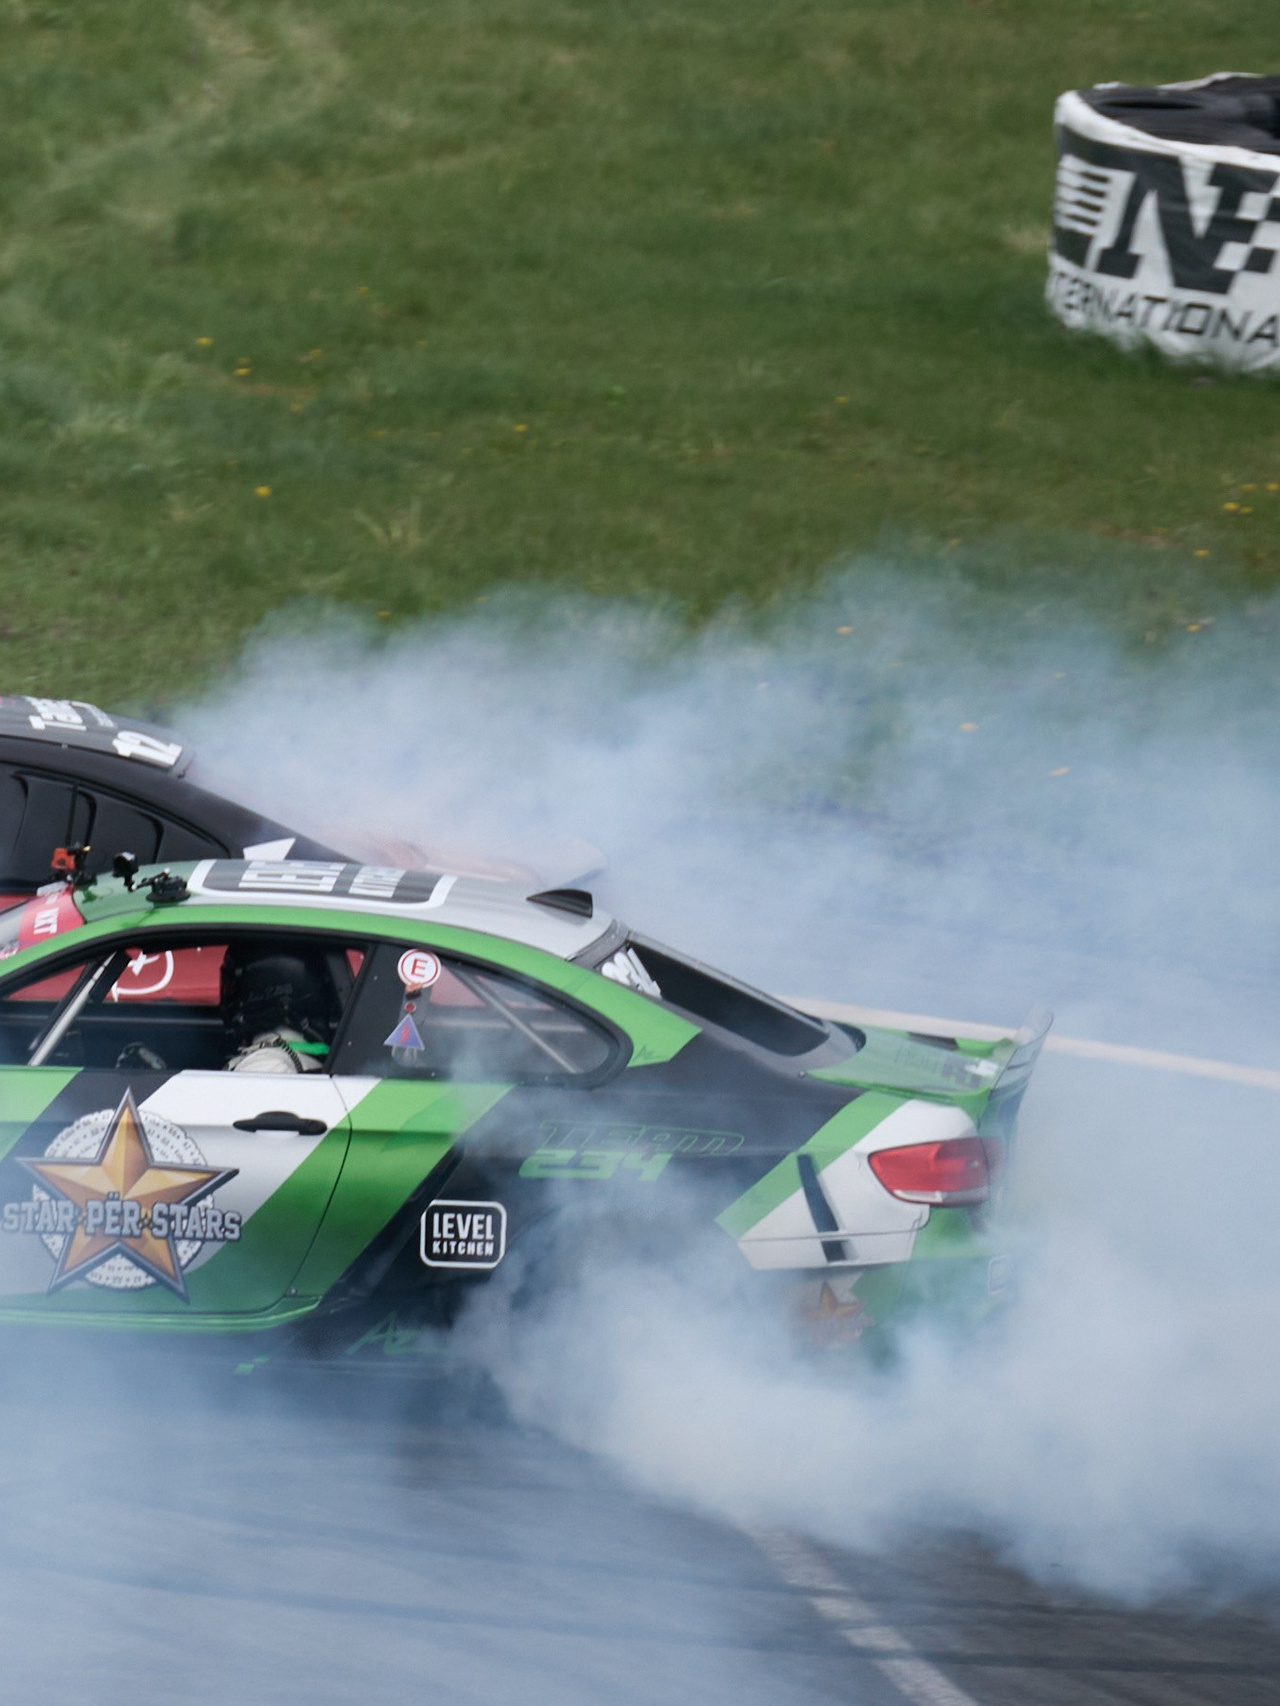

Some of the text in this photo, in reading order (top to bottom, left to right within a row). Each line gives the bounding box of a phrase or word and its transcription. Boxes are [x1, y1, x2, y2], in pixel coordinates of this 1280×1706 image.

[410, 957, 429, 978] E
[518, 1148, 674, 1182] 234
[3, 1202, 75, 1233] STAR
[151, 1202, 243, 1241] STARS
[432, 1212, 495, 1240] LEVEL
[431, 1240, 495, 1256] KITCHEN
